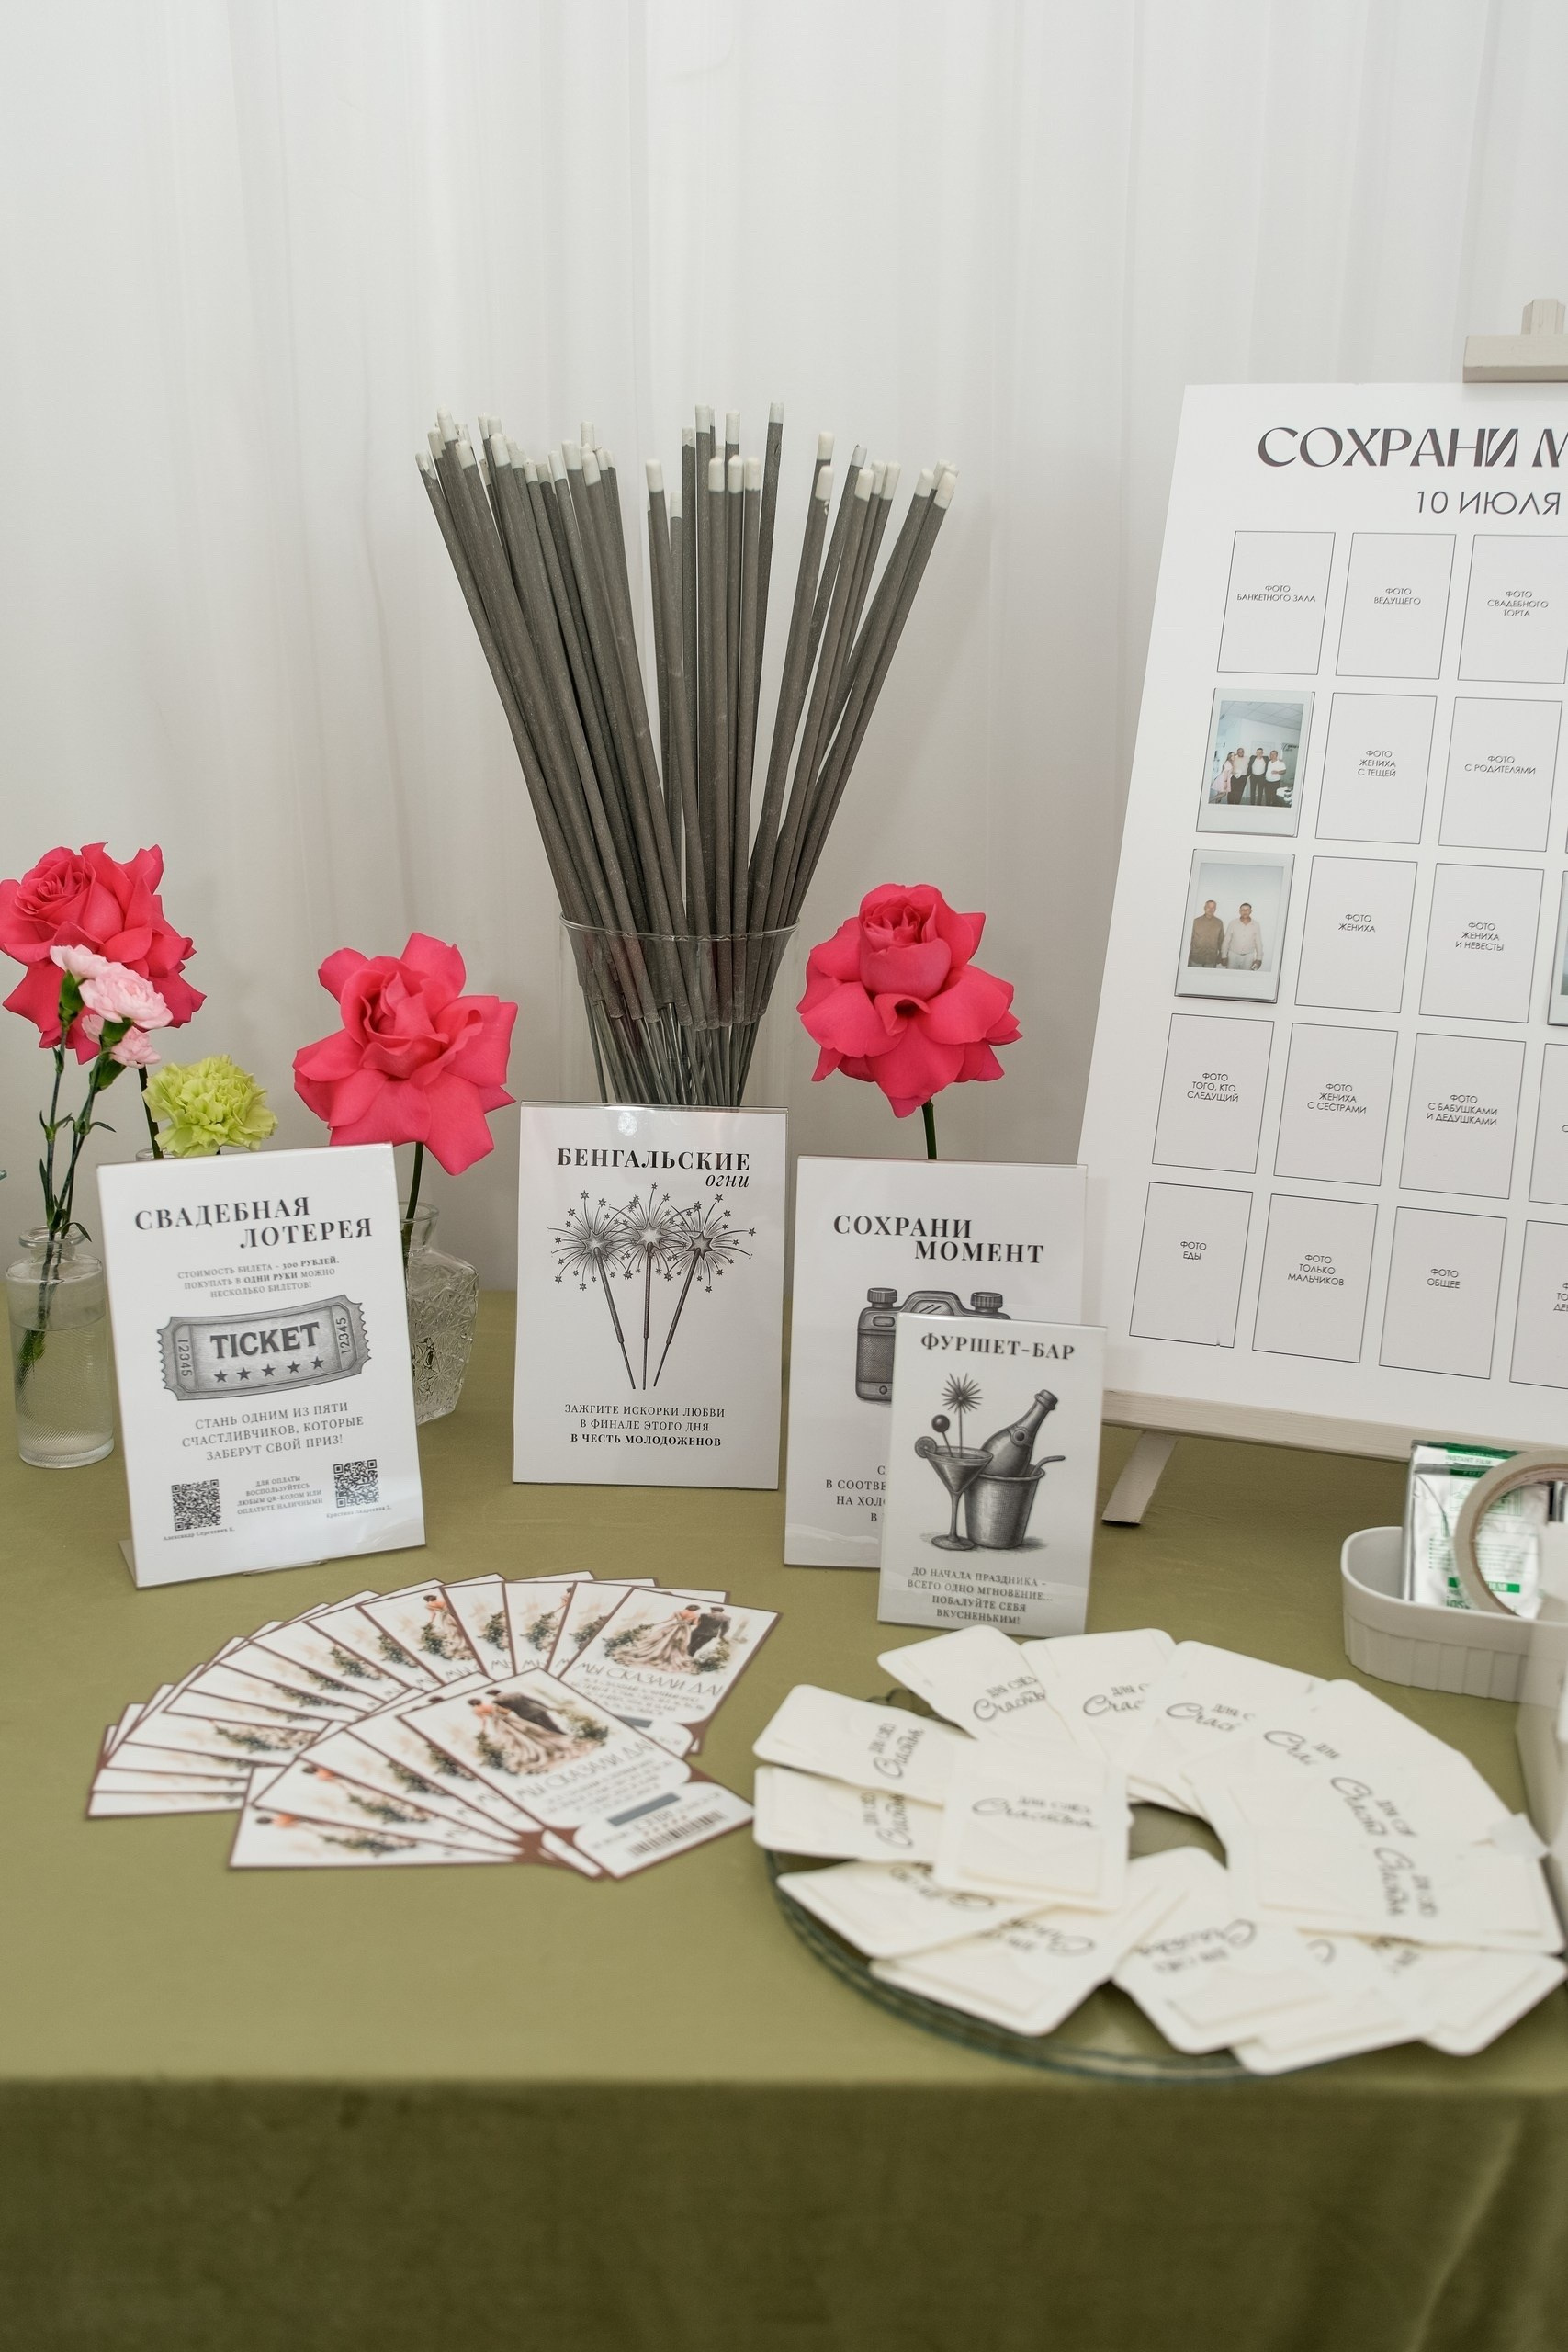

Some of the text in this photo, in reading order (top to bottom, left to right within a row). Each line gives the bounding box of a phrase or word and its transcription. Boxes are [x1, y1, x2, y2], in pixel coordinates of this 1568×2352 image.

[1258, 427, 1518, 468] СОХРАНИ
[1417, 491, 1561, 514] 10 ИЮЛЯ
[1265, 584, 1291, 593] ФОТО
[1386, 587, 1412, 595] ФОТО
[1506, 590, 1532, 598] ФОТО
[1237, 594, 1292, 602] БАНКЕТНОГО
[1374, 597, 1421, 605] ВЕДУЩЕГО
[1487, 599, 1549, 608] СВАДЕБНОГО
[1503, 609, 1530, 617] ТОРТА
[1366, 750, 1393, 758] ФОТО
[1488, 755, 1515, 763] ФОТО
[1359, 759, 1396, 767] ЖЕНИХА
[1358, 768, 1396, 777] С ТЕЩЕЙ
[1464, 763, 1536, 775] С РОДИТЕЛЯМИ
[1345, 914, 1371, 922] ФОТО
[1338, 923, 1375, 933] ЖЕНИХА
[1469, 922, 1495, 931] ФОТО
[1461, 932, 1499, 941] ЖЕНИХА
[1456, 941, 1504, 951] И НЕВЕСТЫ
[1202, 1073, 1228, 1081] ФОТО
[1193, 1081, 1236, 1092] ТОГО, КТО
[1326, 1083, 1353, 1092] ФОТО
[1187, 1091, 1239, 1102] СЛЕДУЩИЙ
[1319, 1092, 1357, 1102] ЖЕНИХА
[1450, 1094, 1477, 1103] ФОТО
[1317, 1102, 1367, 1114] СЕСТРАМИ
[1438, 1104, 1498, 1115] БАБУШКАМИ
[1435, 1114, 1497, 1125] ДЕДУШКАМИ
[558, 1148, 750, 1171] БЕНГАЛЬСКИЕ
[705, 1174, 750, 1188] огни
[135, 1197, 310, 1230] СВАДЕБНАЯ
[834, 1215, 972, 1238] СОХРАНИ
[240, 1218, 372, 1248] ЛОТЕРЕЯ
[1180, 1241, 1207, 1250] ФОТО
[915, 1241, 1043, 1263] МОМЕНТ
[1183, 1251, 1201, 1260] ЕДЫ
[1305, 1255, 1332, 1264] ФОТО
[178, 1268, 235, 1279] СТОИМОСТЬ
[238, 1264, 272, 1273] БИЛЕТА
[301, 1256, 339, 1267] РУБЛЕЙ.
[1299, 1264, 1336, 1274] ТОЛЬКО
[1431, 1268, 1459, 1278] ФОТО
[185, 1279, 232, 1289] ПОКУПАТЬ
[243, 1275, 270, 1283] ОДНИ
[273, 1272, 298, 1281] РУКИ
[300, 1268, 335, 1278] МОЖНО
[1288, 1273, 1344, 1286] МАЛЬЧИКОВ
[1427, 1278, 1461, 1288] ОБЩЕЕ
[210, 1282, 311, 1298] НЕСКОЛЬКО БИЛЕТОВ!
[210, 1322, 319, 1359] TICKET
[336, 1317, 351, 1354] 12345
[920, 1333, 1075, 1361] ФУРШЕТ-БАР
[196, 1402, 348, 1429] СТАНЬ ОДНИМ ИЗ ПЯТИ
[565, 1404, 725, 1418] ЗАЖГИТЕ ИСКОРКИ ЛЮБВИ
[581, 1419, 709, 1432] В ФИНАЛЕ ЭТОГО ДНЯ
[182, 1416, 364, 1447] СЧАСТЛИВЧИКОВ, КОТОРЫЕ
[582, 1434, 621, 1442] ЧЕСТЬ
[625, 1435, 721, 1446] МОЛОДОЖЕНОВ
[207, 1434, 344, 1461] ЗАБЕРУТ СВОЙ ПРИЗ!
[826, 1479, 832, 1488] В
[837, 1496, 885, 1506] НА ХОЛ
[912, 1567, 926, 1576] ДО
[931, 1568, 971, 1580] НАЧАЛА
[976, 1573, 1038, 1587] ПРАЗДНИКА
[908, 1579, 941, 1589] ВСЕГО
[944, 1583, 974, 1593] ОДНО
[932, 1596, 1026, 1612] ПОБАЛУЙТЕ СЕБЯ
[937, 1609, 1021, 1624] ВКУСНЕНЬКИМ!
